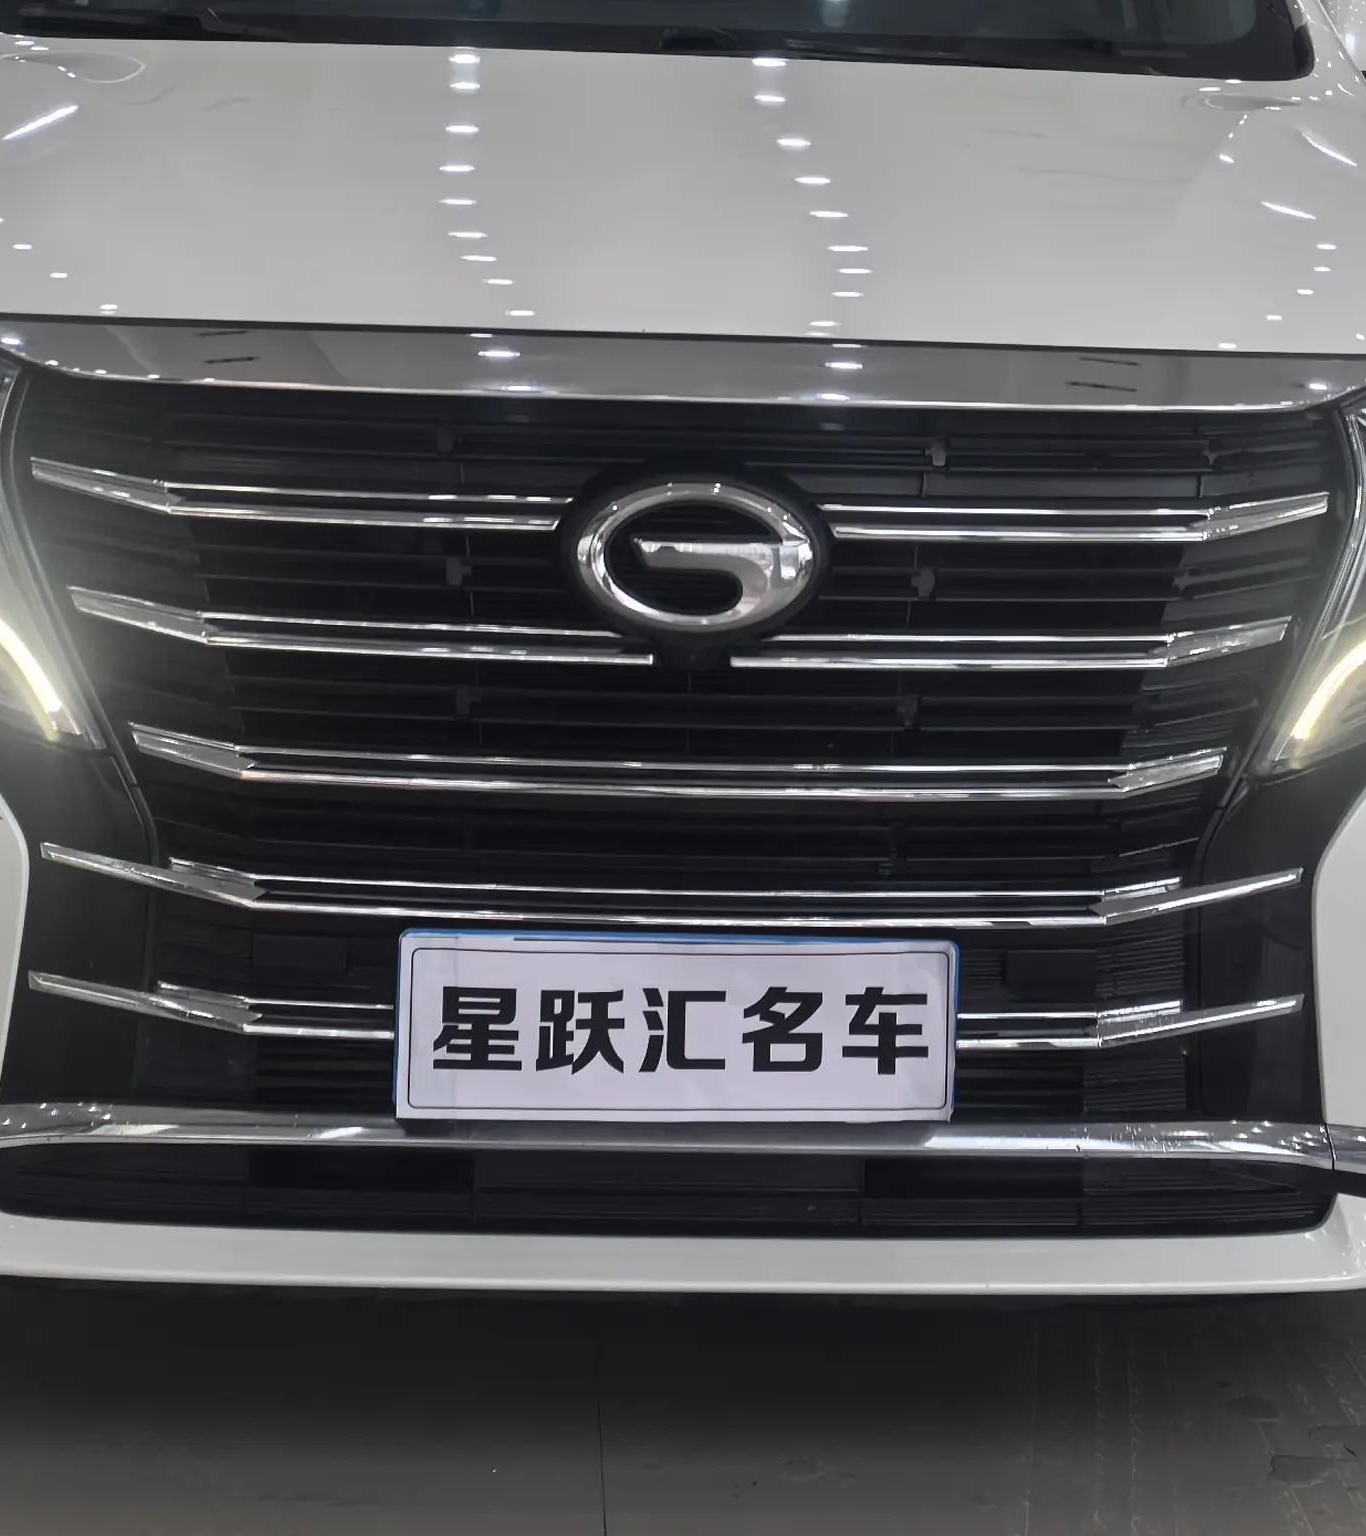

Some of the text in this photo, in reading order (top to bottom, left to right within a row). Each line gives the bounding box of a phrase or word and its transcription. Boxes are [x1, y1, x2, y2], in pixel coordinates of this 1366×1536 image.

[433, 986, 930, 1075] 星跃汇名车
